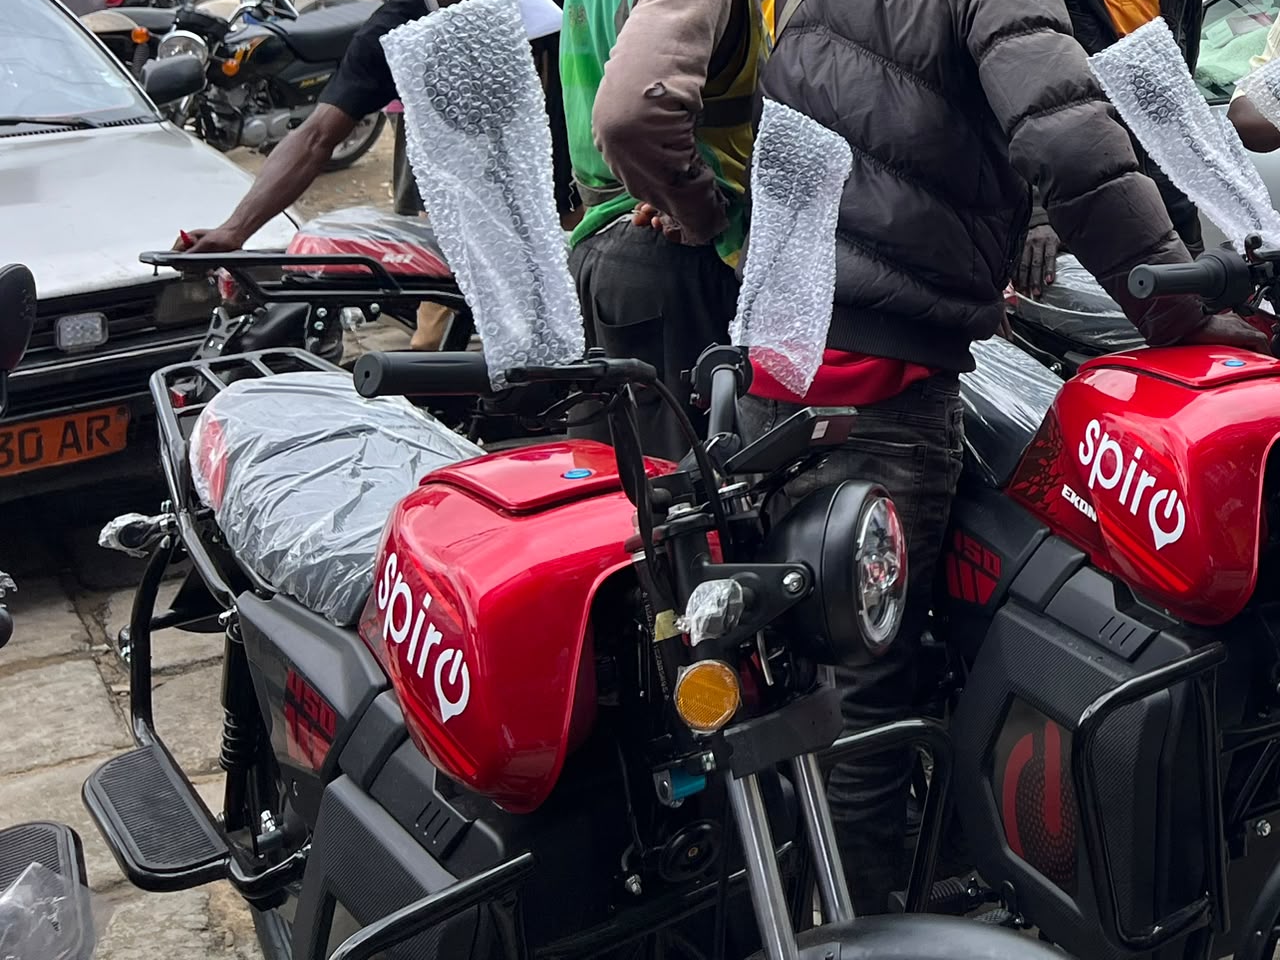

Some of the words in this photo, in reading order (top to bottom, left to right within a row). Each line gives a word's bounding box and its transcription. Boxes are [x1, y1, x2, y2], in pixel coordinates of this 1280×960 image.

[58, 415, 111, 458] AR
[1061, 483, 1098, 523] EKON
[1078, 419, 1186, 551] spiro
[377, 552, 471, 724] spiro
